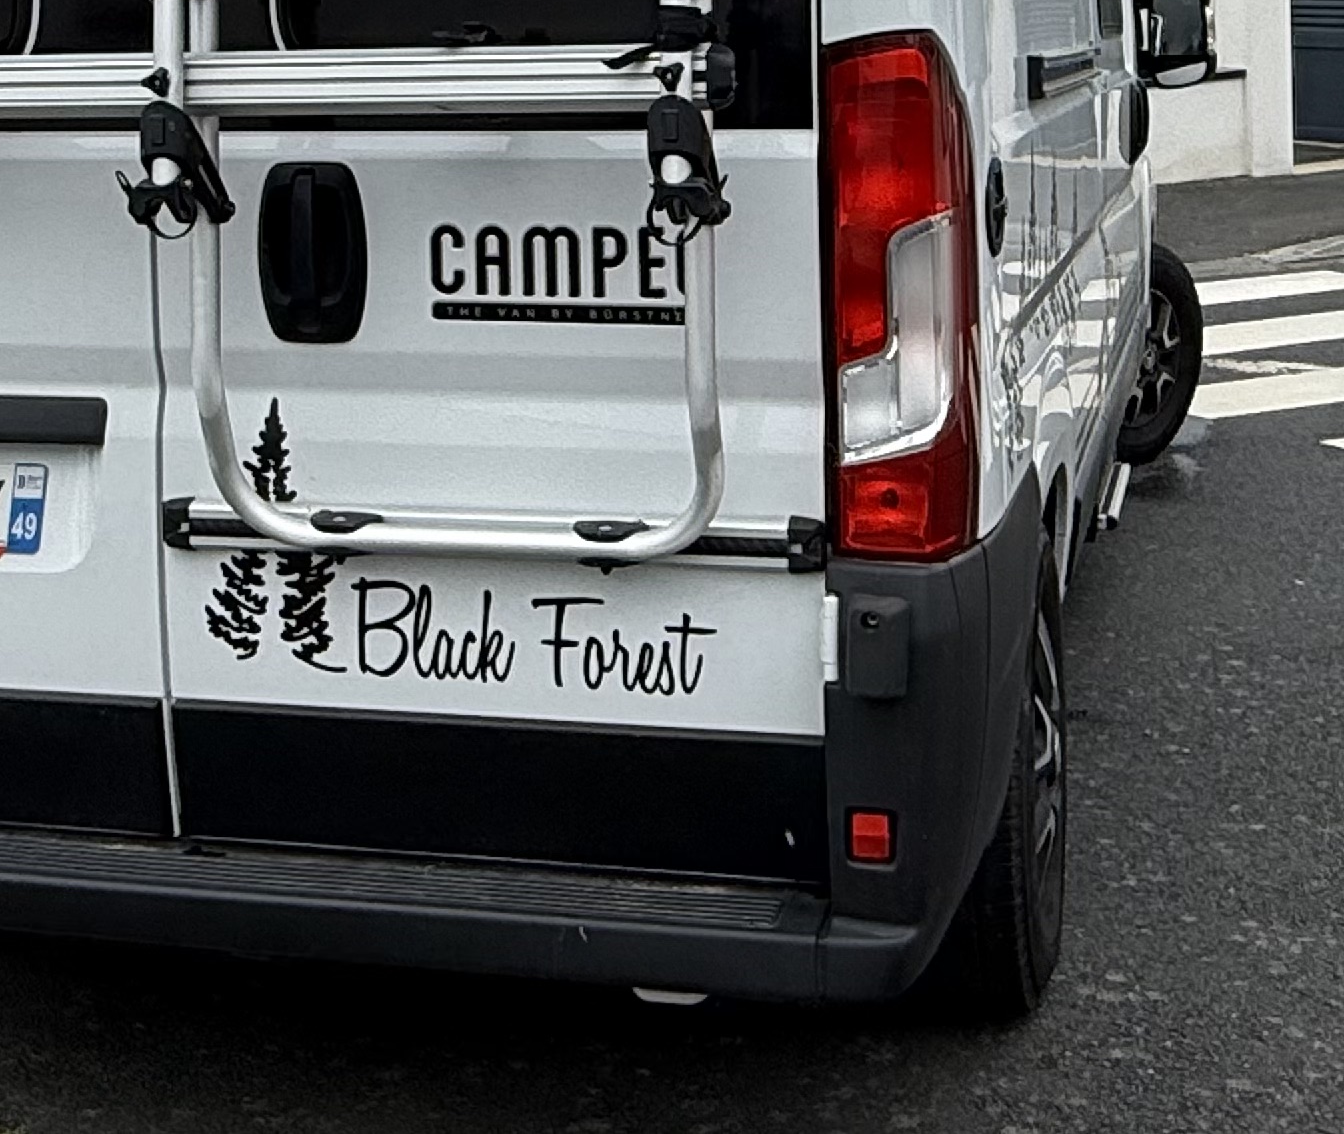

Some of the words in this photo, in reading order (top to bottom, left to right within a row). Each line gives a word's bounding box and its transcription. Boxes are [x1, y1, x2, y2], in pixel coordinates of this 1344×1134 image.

[430, 225, 685, 298] CAMPE
[447, 306, 482, 317] THE
[497, 307, 535, 318] VAN
[11, 512, 37, 540] 49
[351, 577, 516, 684] Black
[531, 598, 718, 695] Forest
